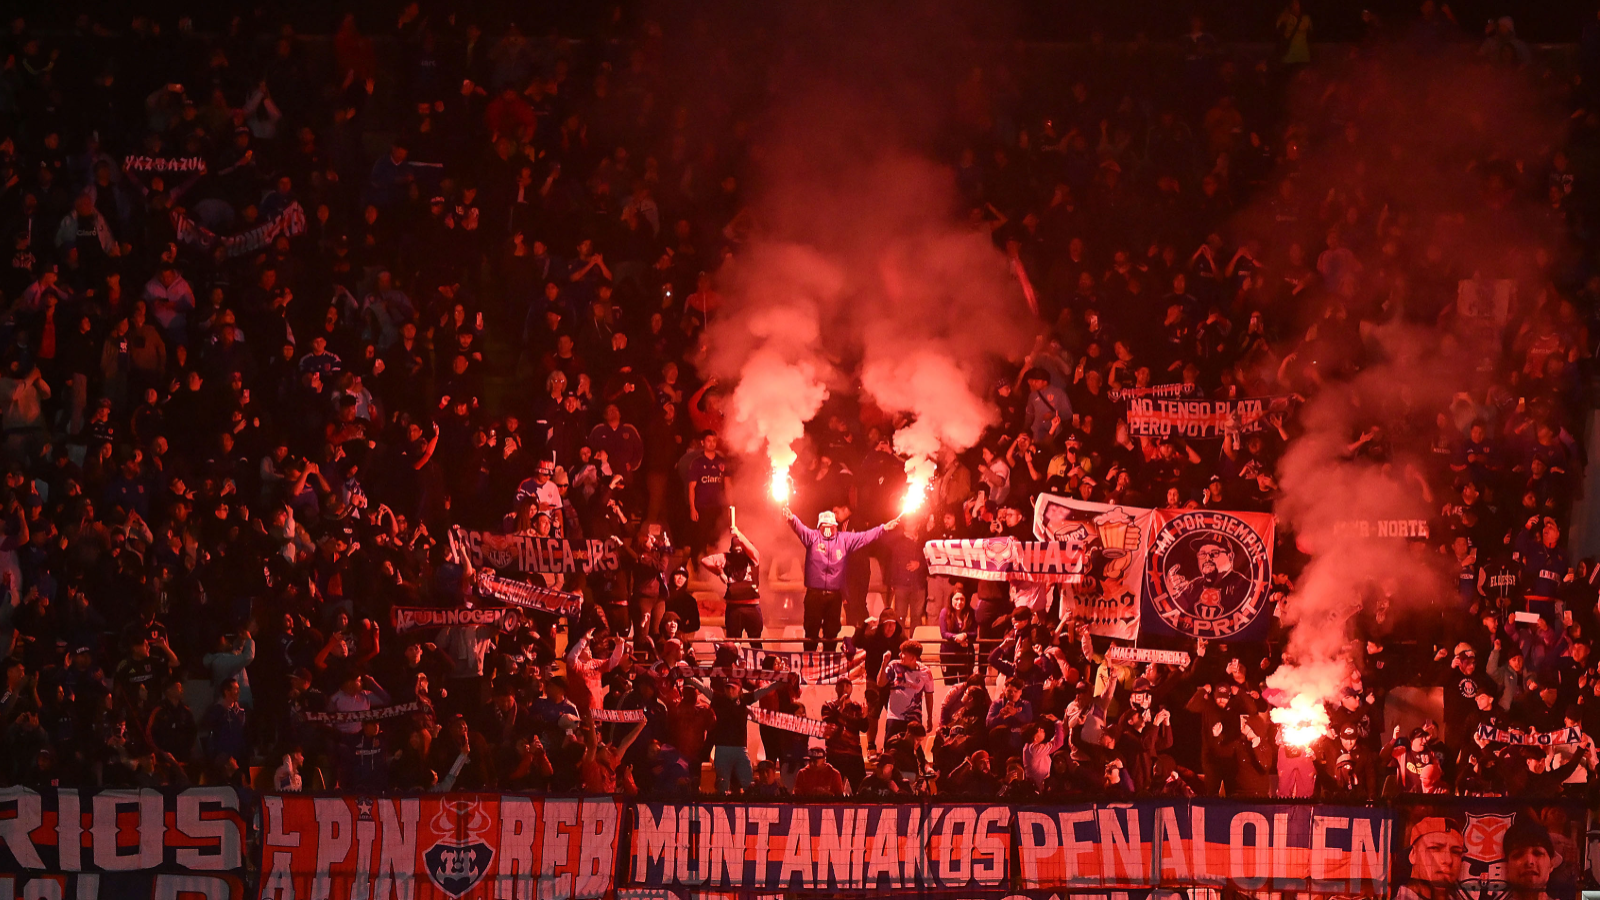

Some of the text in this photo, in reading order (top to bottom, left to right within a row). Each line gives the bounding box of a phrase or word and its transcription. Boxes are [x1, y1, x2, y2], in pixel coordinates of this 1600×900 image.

[1129, 417, 1172, 435] PERO
[1177, 419, 1211, 437] VOY
[1131, 399, 1152, 417] NO
[1173, 514, 1206, 535] POR
[1211, 514, 1267, 564] SIEMPRE
[1378, 520, 1427, 537] NORTE
[513, 536, 576, 573] TALCA
[582, 538, 620, 574] JRS
[396, 608, 518, 634] AZULINOGENO
[1153, 592, 1181, 628] LA
[1193, 597, 1258, 637] PRAT
[0, 785, 242, 871] RIOS
[497, 796, 617, 898] REB
[635, 803, 1010, 889] MONTANIAKOS
[1017, 803, 1392, 893] PEÑALOLEN
